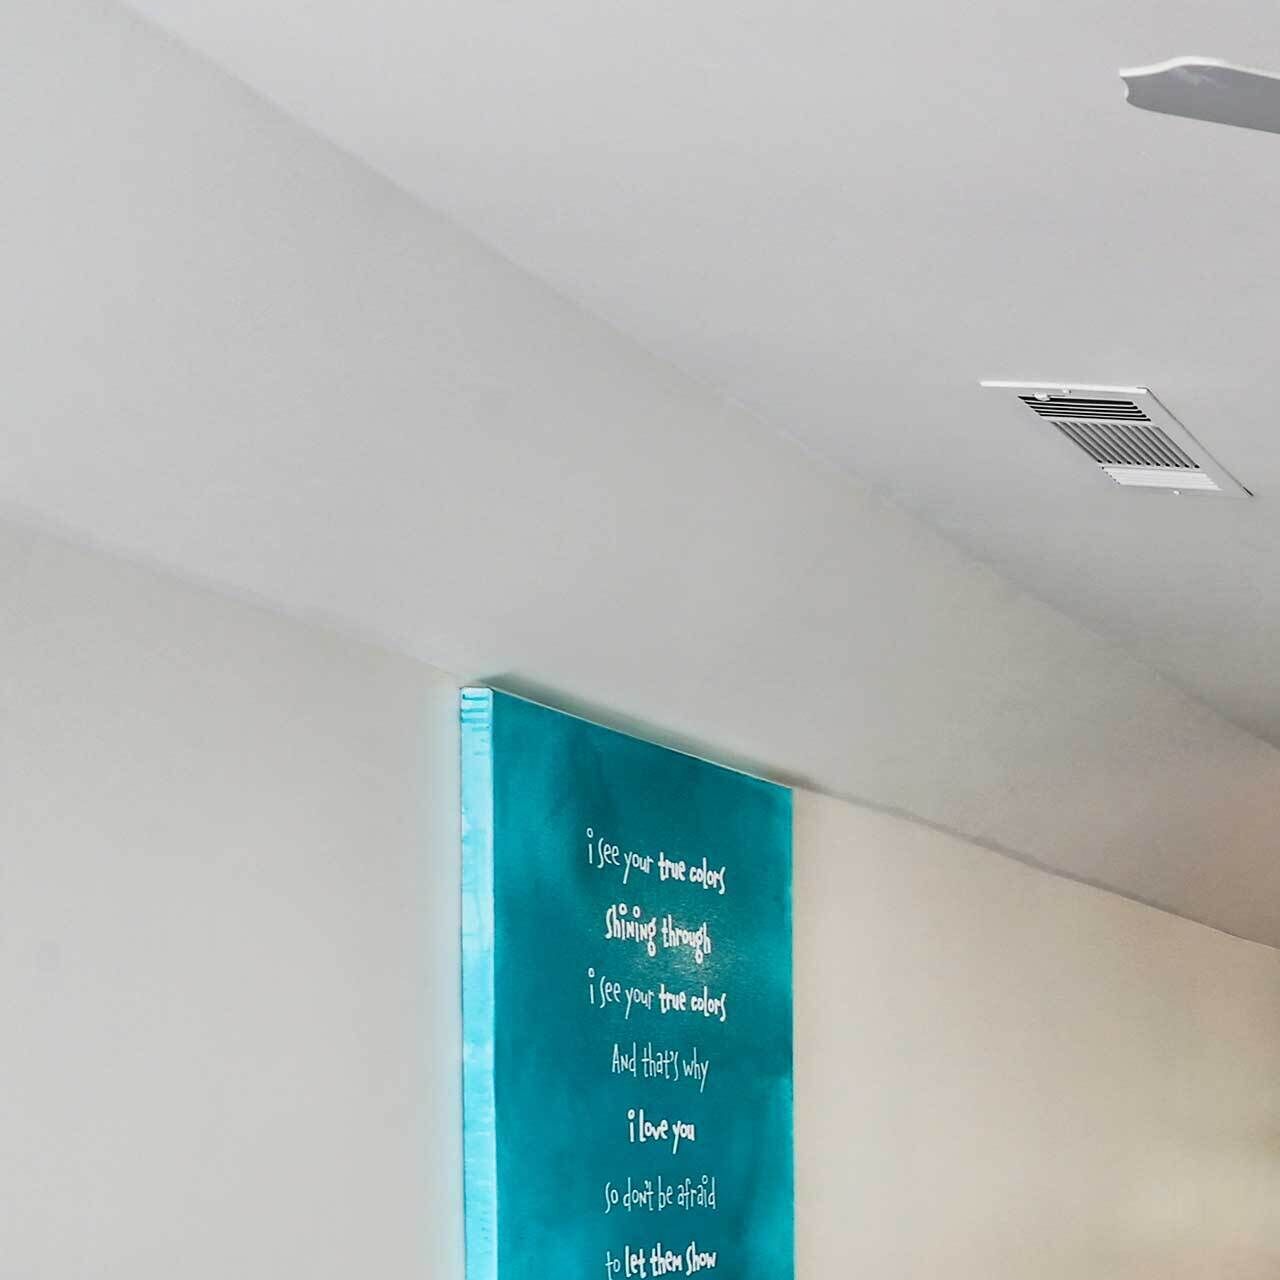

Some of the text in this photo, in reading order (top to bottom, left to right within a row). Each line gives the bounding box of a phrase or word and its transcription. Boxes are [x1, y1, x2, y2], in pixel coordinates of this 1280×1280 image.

[586, 827, 594, 864] i
[623, 851, 654, 885] your
[658, 851, 686, 882] true
[689, 857, 726, 895] colors
[661, 914, 712, 964] through
[587, 967, 595, 1005] i
[624, 987, 655, 1020] your
[658, 983, 687, 1014] true
[690, 985, 727, 1022] colors
[611, 1042, 710, 1094] And that's why
[627, 1109, 696, 1155] i love you
[623, 1177, 654, 1212] don't
[658, 1175, 673, 1212] be
[677, 1174, 716, 1211] afraid
[625, 1245, 646, 1279] let
[649, 1242, 682, 1277] them
